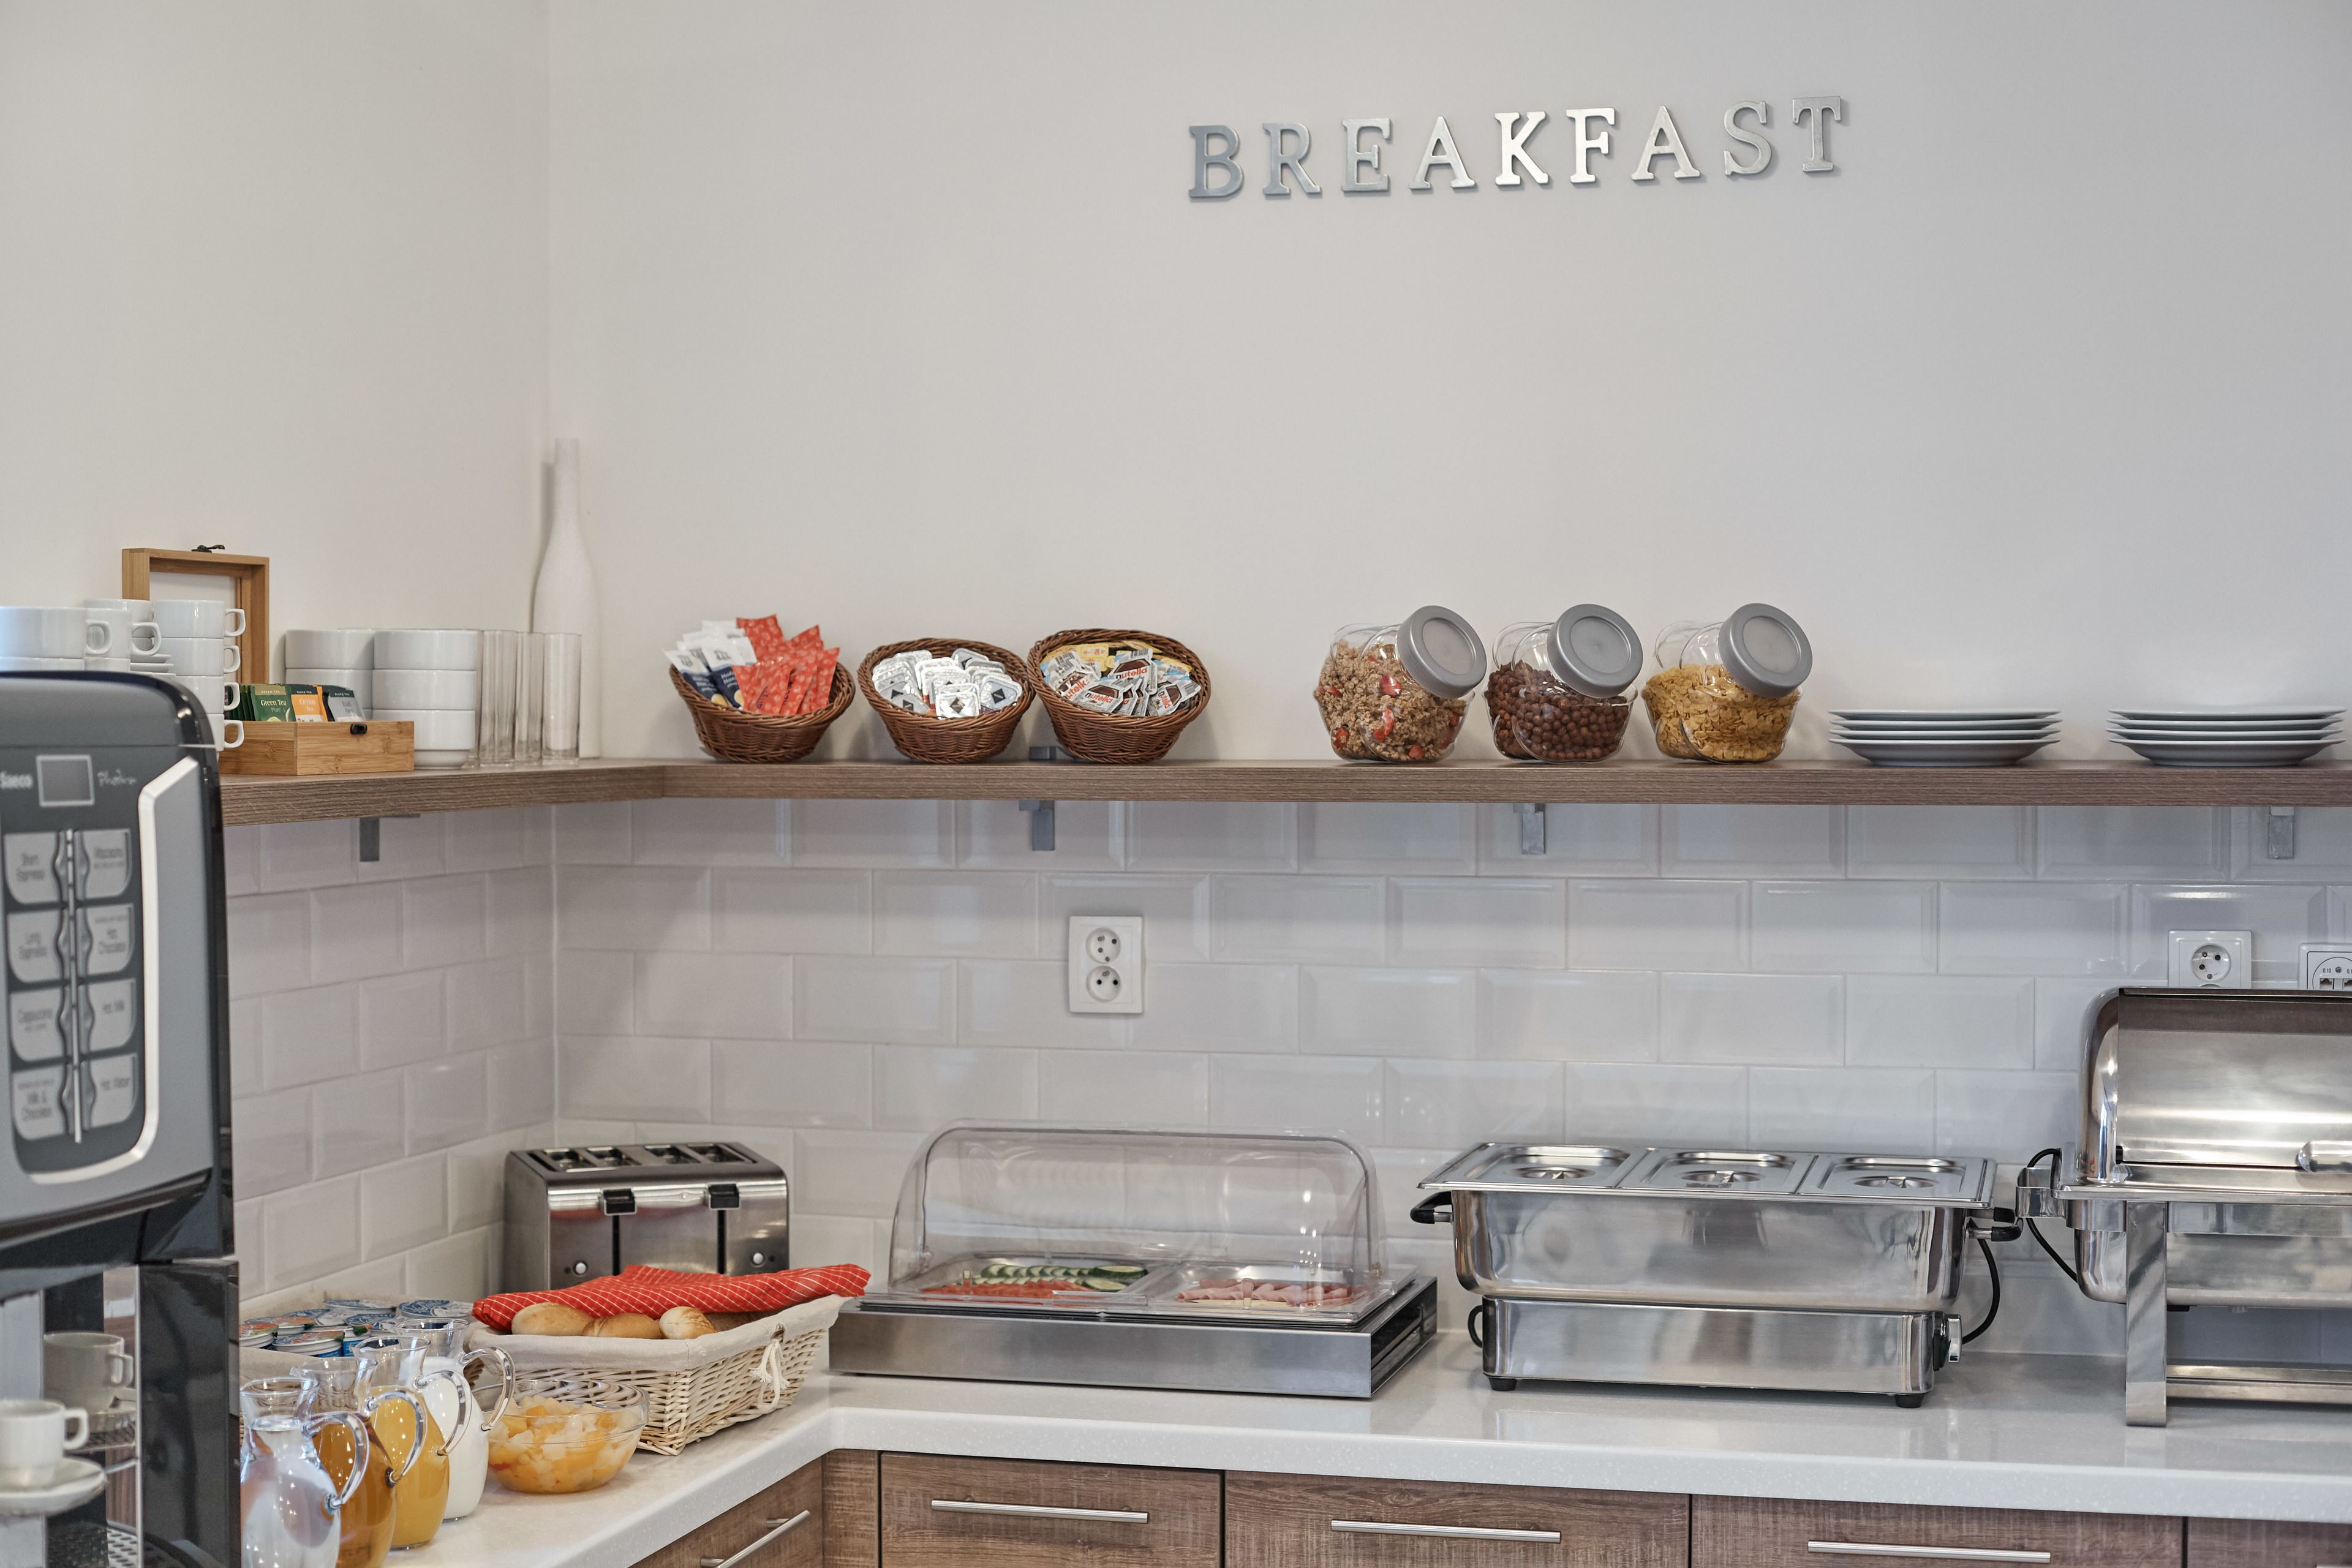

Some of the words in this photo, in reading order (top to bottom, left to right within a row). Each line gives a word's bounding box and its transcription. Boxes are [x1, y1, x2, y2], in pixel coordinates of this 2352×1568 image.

[1189, 96, 1842, 198] BREAKFAST
[1116, 667, 1147, 679] nutella
[1085, 692, 1113, 703] nutella
